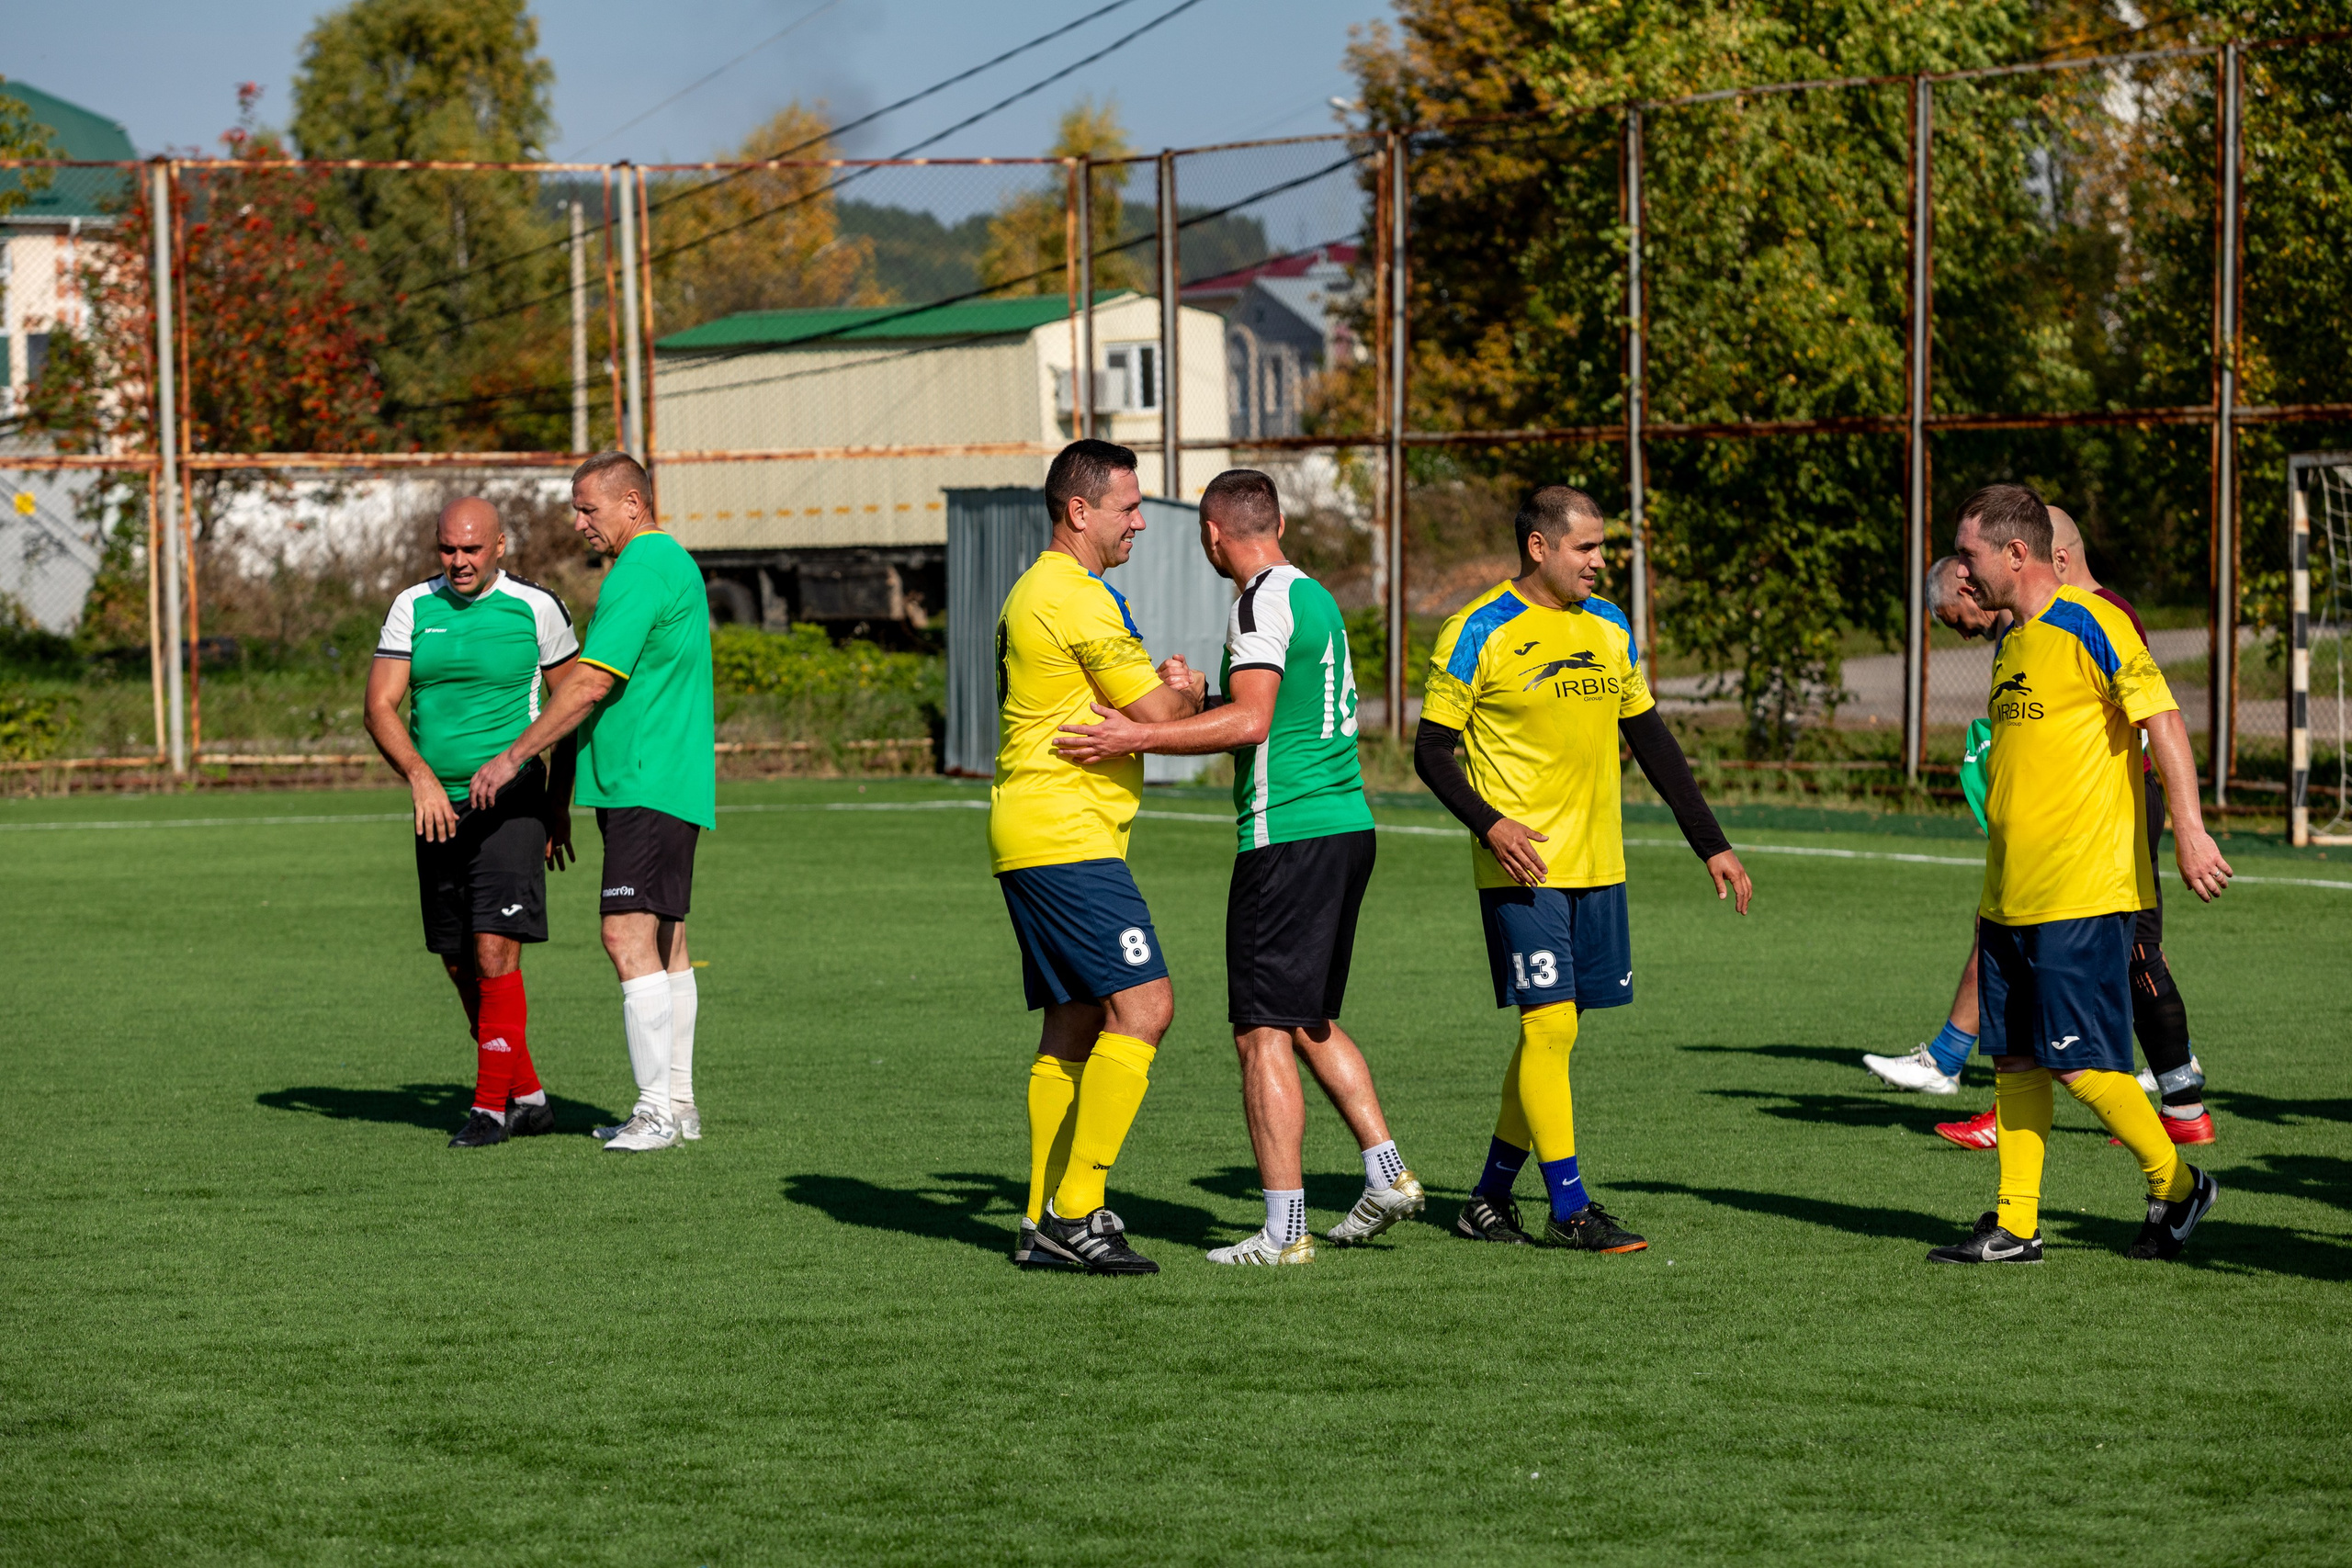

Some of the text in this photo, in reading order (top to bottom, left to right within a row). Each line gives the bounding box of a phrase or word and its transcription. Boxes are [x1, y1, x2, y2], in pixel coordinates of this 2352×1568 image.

[1555, 677, 1620, 698] IRBIS
[1996, 702, 2044, 722] IRBIS
[1118, 926, 1151, 966] 8
[1511, 949, 1559, 989] 13
